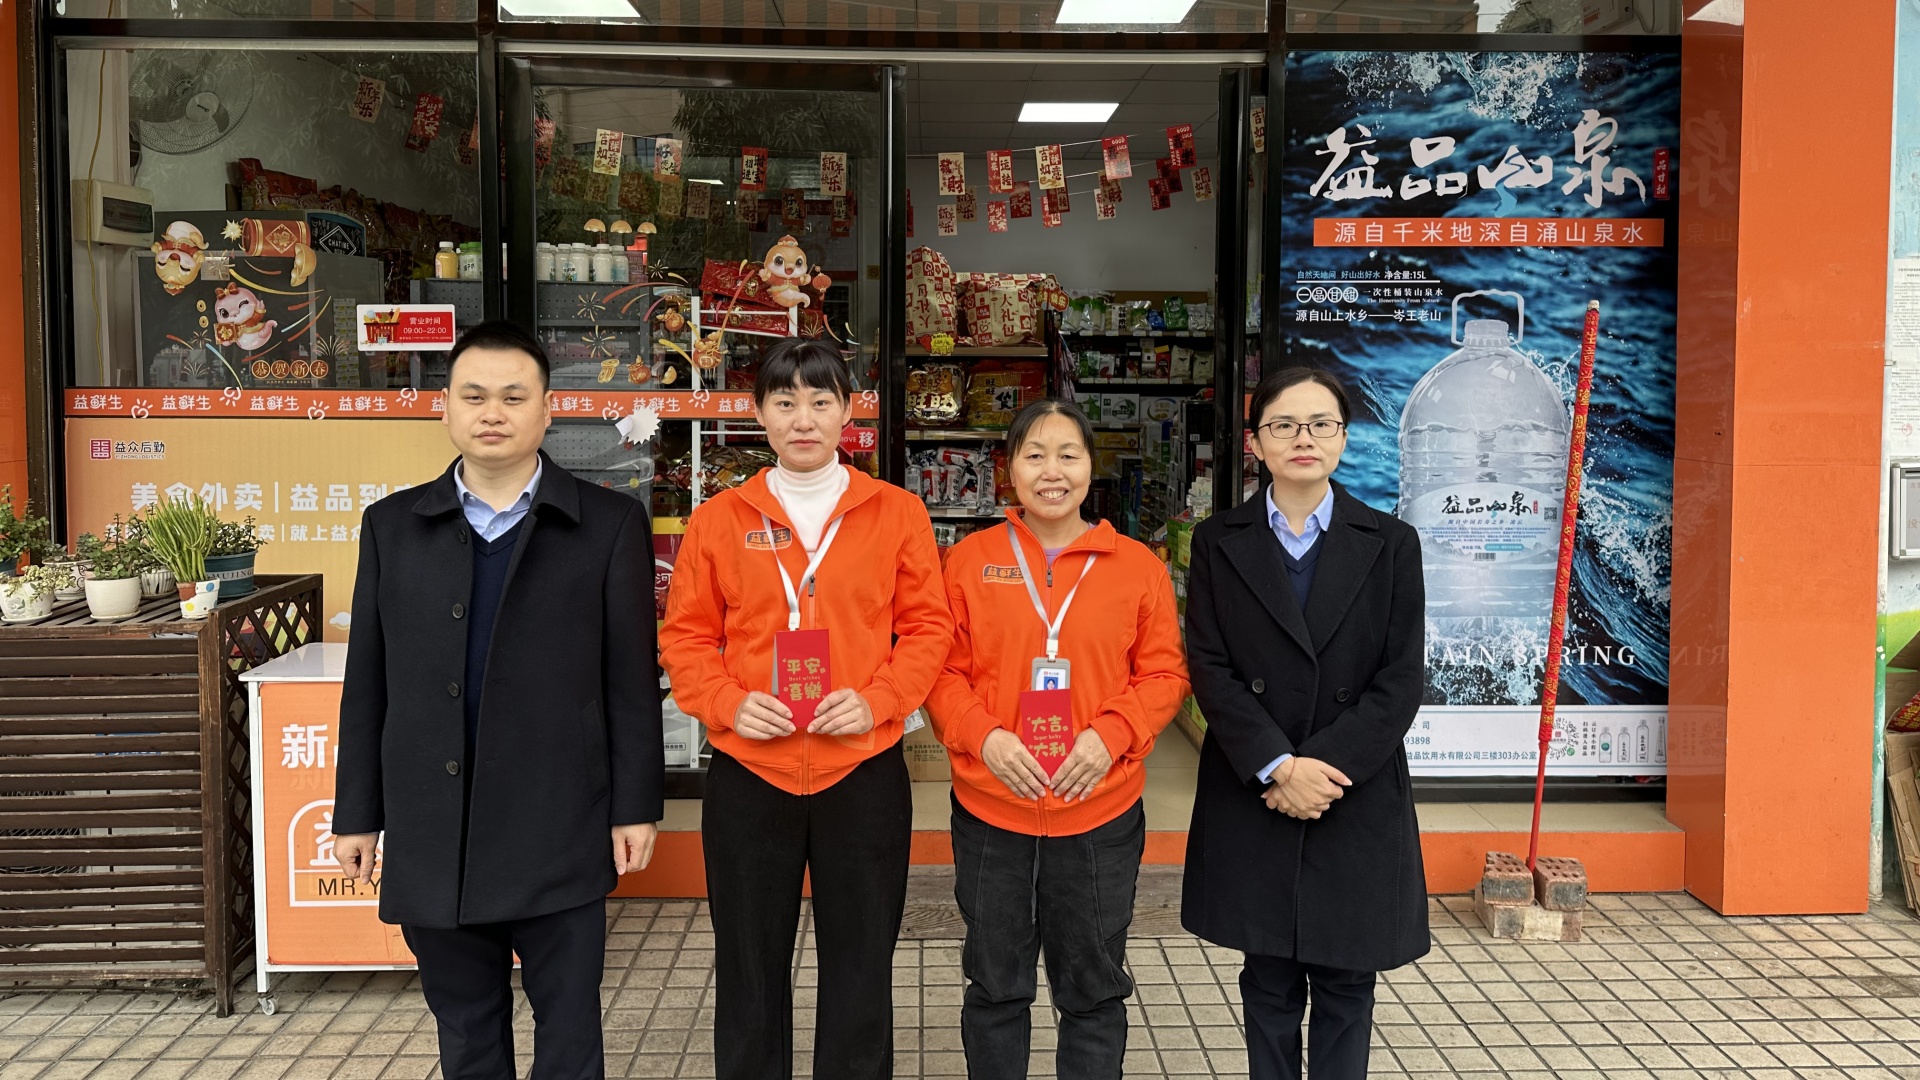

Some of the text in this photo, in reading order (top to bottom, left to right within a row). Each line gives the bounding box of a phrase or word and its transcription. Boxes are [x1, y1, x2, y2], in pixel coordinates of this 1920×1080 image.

[1310, 109, 1646, 208] 益品山泉
[1333, 222, 1646, 243] 源自千米地深自涌山泉水
[1297, 270, 1427, 280] 自然天地间 好山出好水 净含量:15L
[1296, 287, 1359, 303] 一品甘甜
[1363, 287, 1443, 298] 一次性桶装山泉水
[409, 317, 441, 325] 营业时间
[1001, 293, 1015, 337] 大礼包
[254, 361, 327, 377] 恭贺新春
[73, 394, 123, 410] 益鲜生
[161, 394, 211, 411] 益鲜生
[250, 395, 299, 411] 益鲜生
[338, 396, 388, 412] 益鲜生
[114, 441, 165, 453] 益众后勤
[858, 431, 875, 448] 移
[1441, 491, 1533, 516] 益品山泉
[787, 657, 821, 675] 平安
[1031, 715, 1062, 733] 大吉
[1405, 736, 1431, 745] 93898
[1033, 742, 1066, 758] 大利
[1406, 751, 1537, 761] 益品饮用水有限公司三楼303办公室
